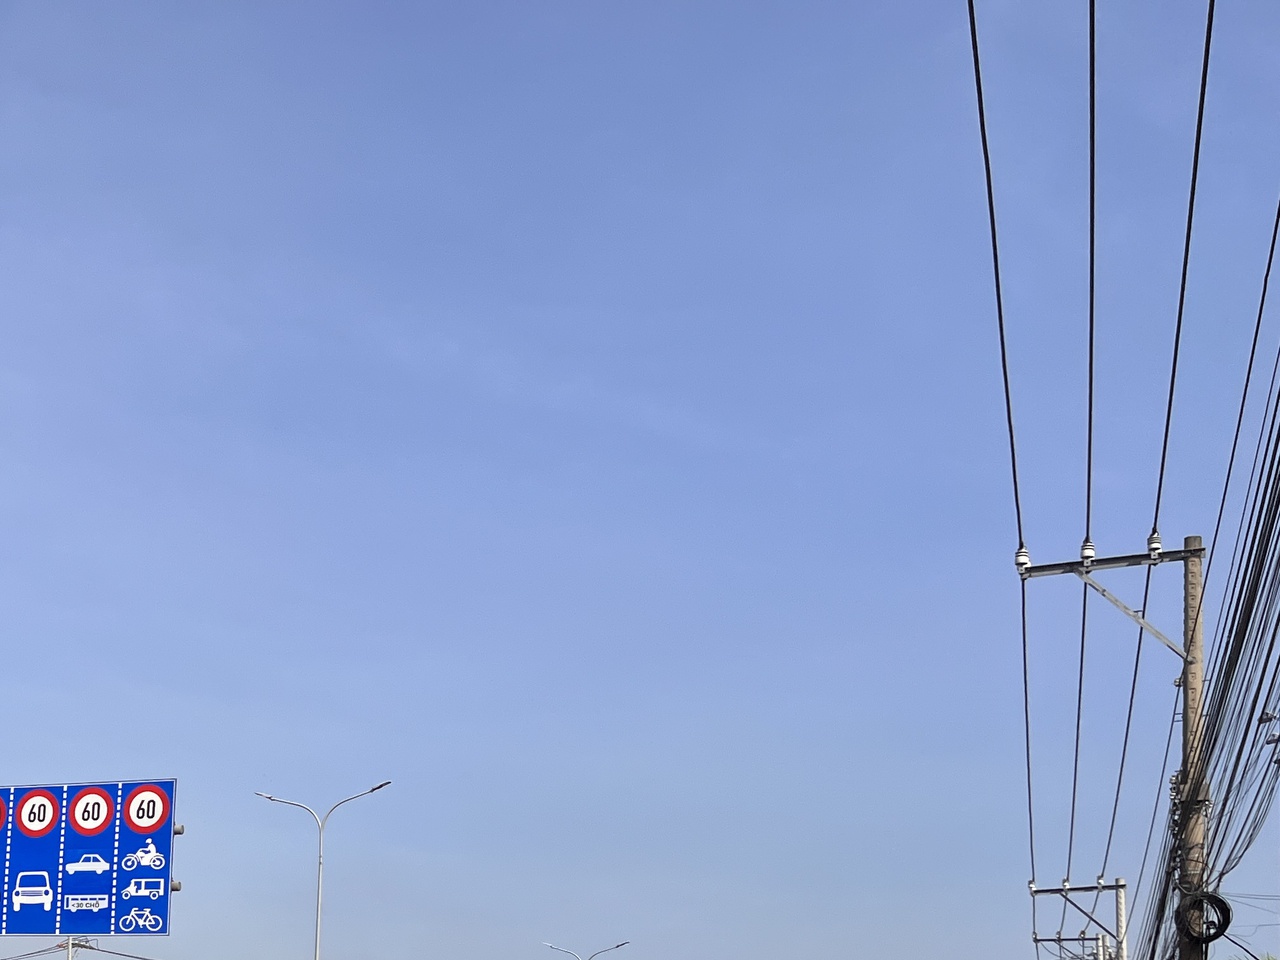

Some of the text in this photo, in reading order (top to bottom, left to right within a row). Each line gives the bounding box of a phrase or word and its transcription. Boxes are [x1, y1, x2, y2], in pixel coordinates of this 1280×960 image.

[28, 803, 46, 822] 60
[81, 802, 100, 821] 60
[136, 799, 155, 819] 60
